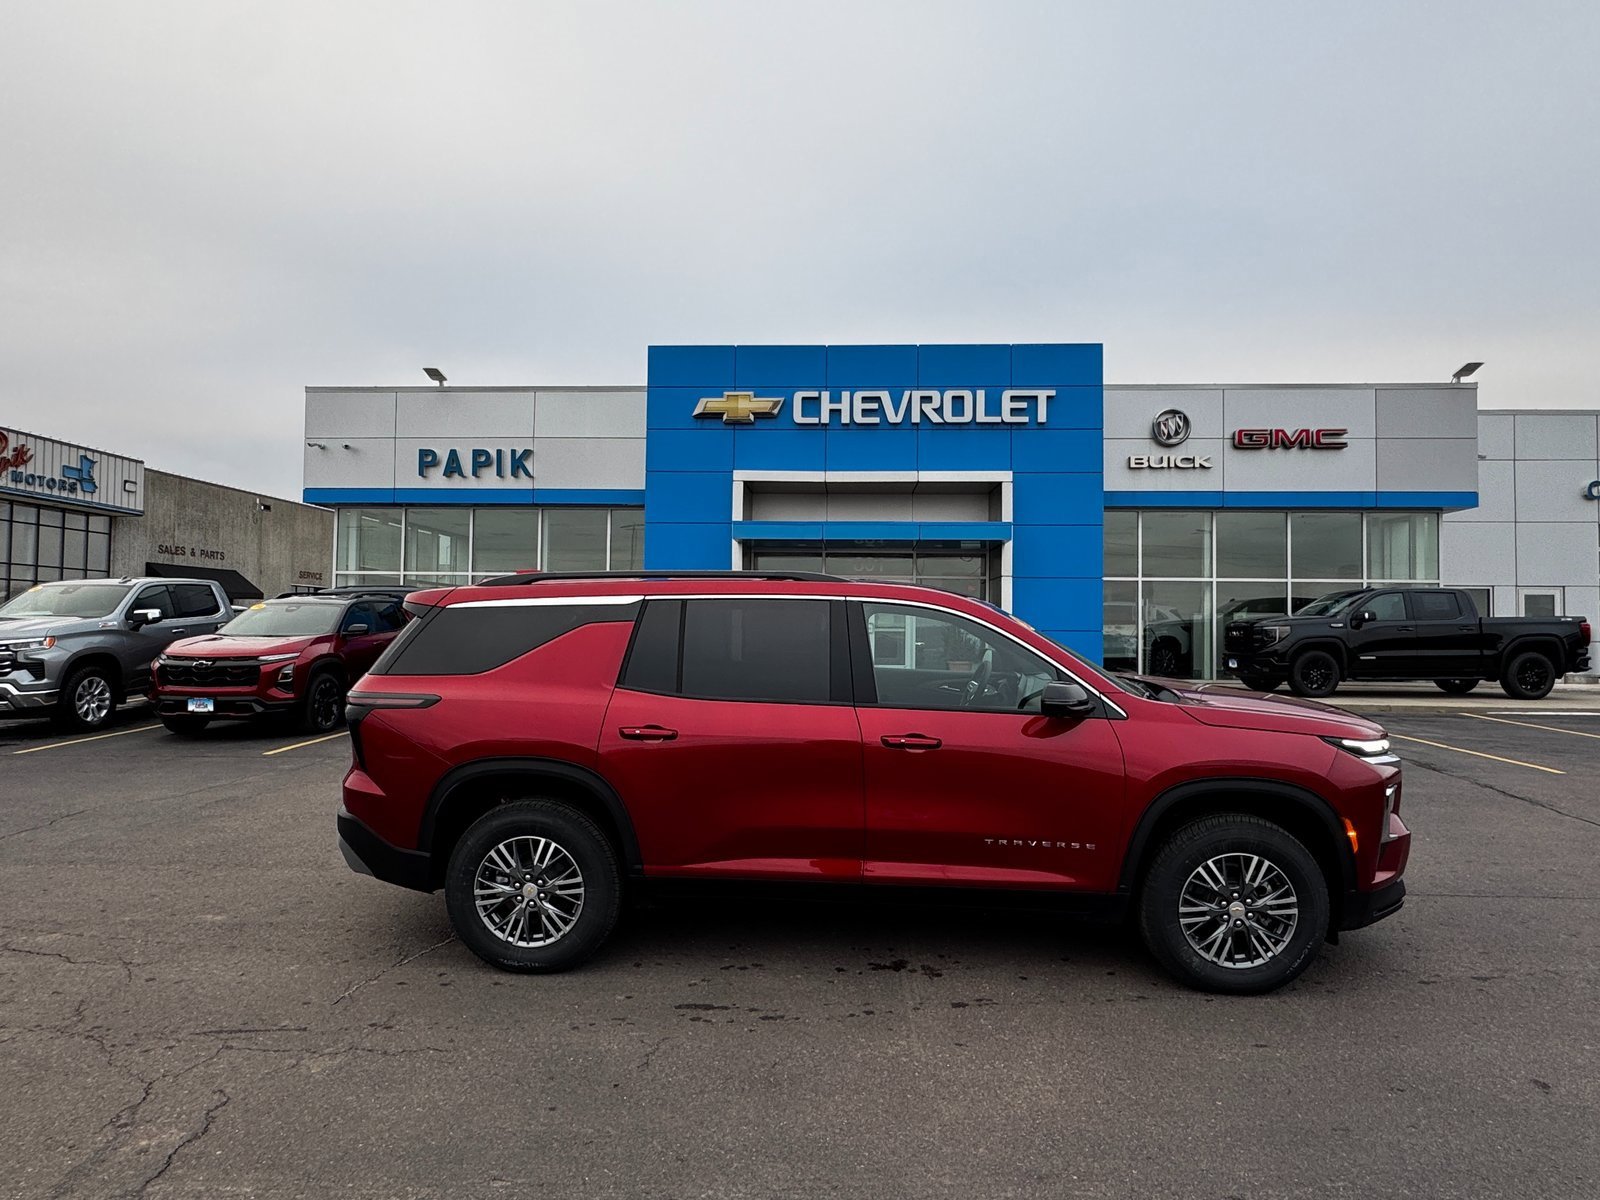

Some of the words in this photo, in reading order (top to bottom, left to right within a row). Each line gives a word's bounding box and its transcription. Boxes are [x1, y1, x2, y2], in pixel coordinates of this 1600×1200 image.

[793, 389, 1056, 425] CHEVROLET
[1233, 428, 1348, 449] GMC
[418, 448, 534, 478] PAPIK
[1128, 455, 1212, 469] BUICK
[11, 470, 78, 493] MOTORS
[157, 544, 186, 556] SALES
[189, 547, 197, 557] &
[200, 549, 225, 561] PARTS
[298, 570, 323, 581] SERVICE
[984, 838, 1096, 850] TRAVERSE
